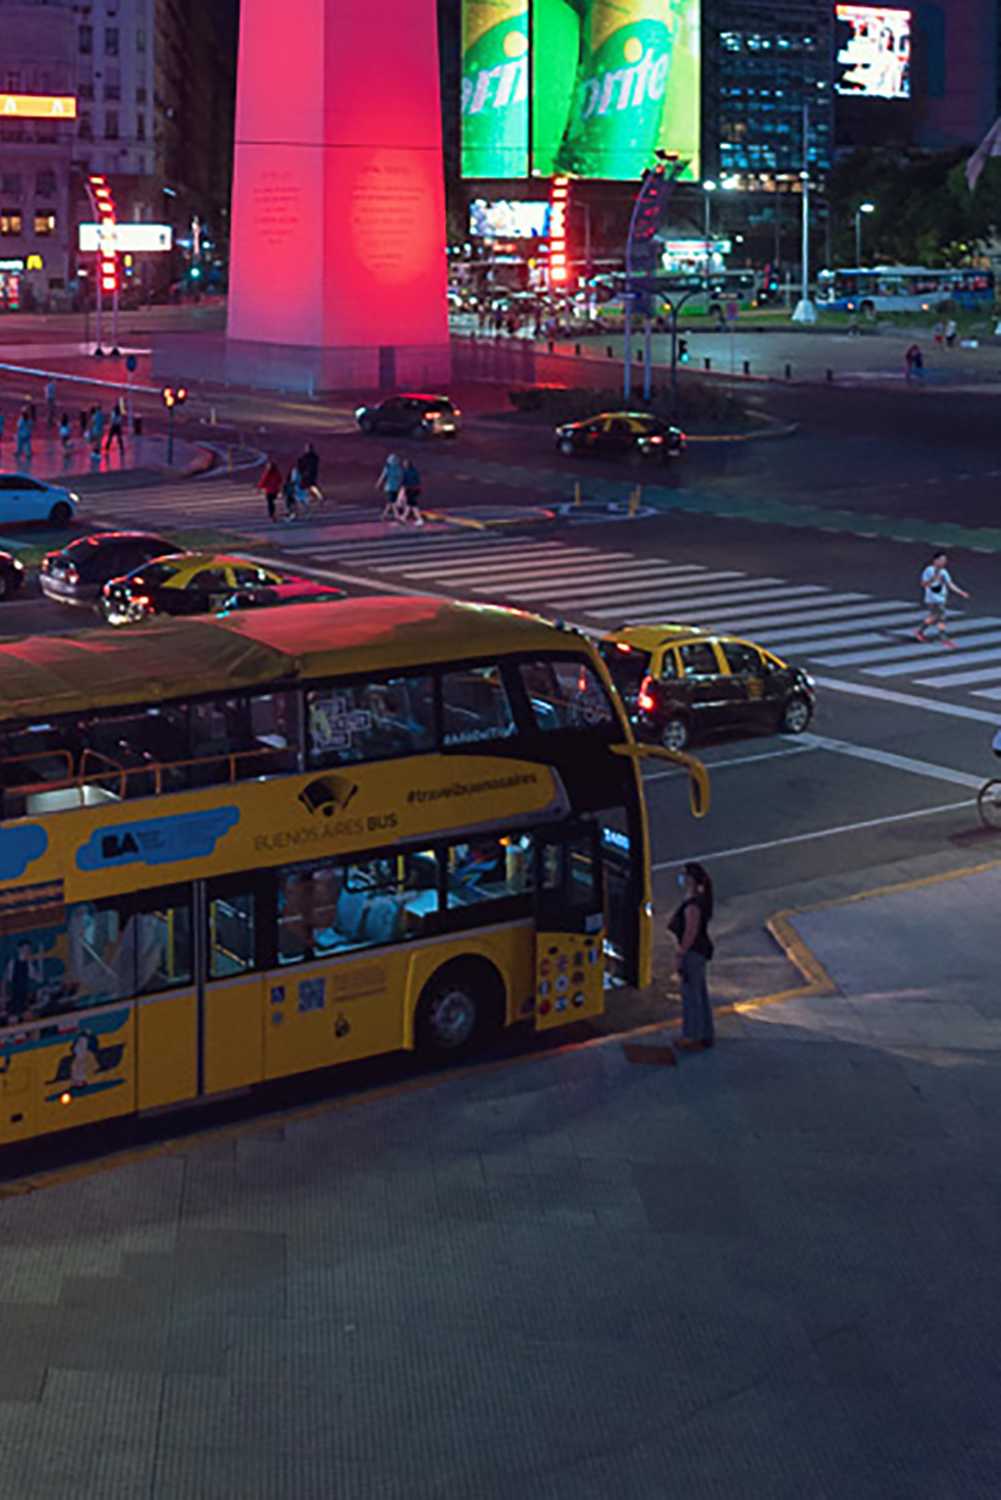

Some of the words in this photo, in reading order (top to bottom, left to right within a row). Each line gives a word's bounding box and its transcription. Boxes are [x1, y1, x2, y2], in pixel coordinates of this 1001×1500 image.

[407, 772, 537, 803] #travelbuenosaires
[101, 831, 139, 859] BA
[255, 826, 319, 850] BUENOS
[322, 817, 363, 839] AIRES
[366, 811, 398, 831] BUS
